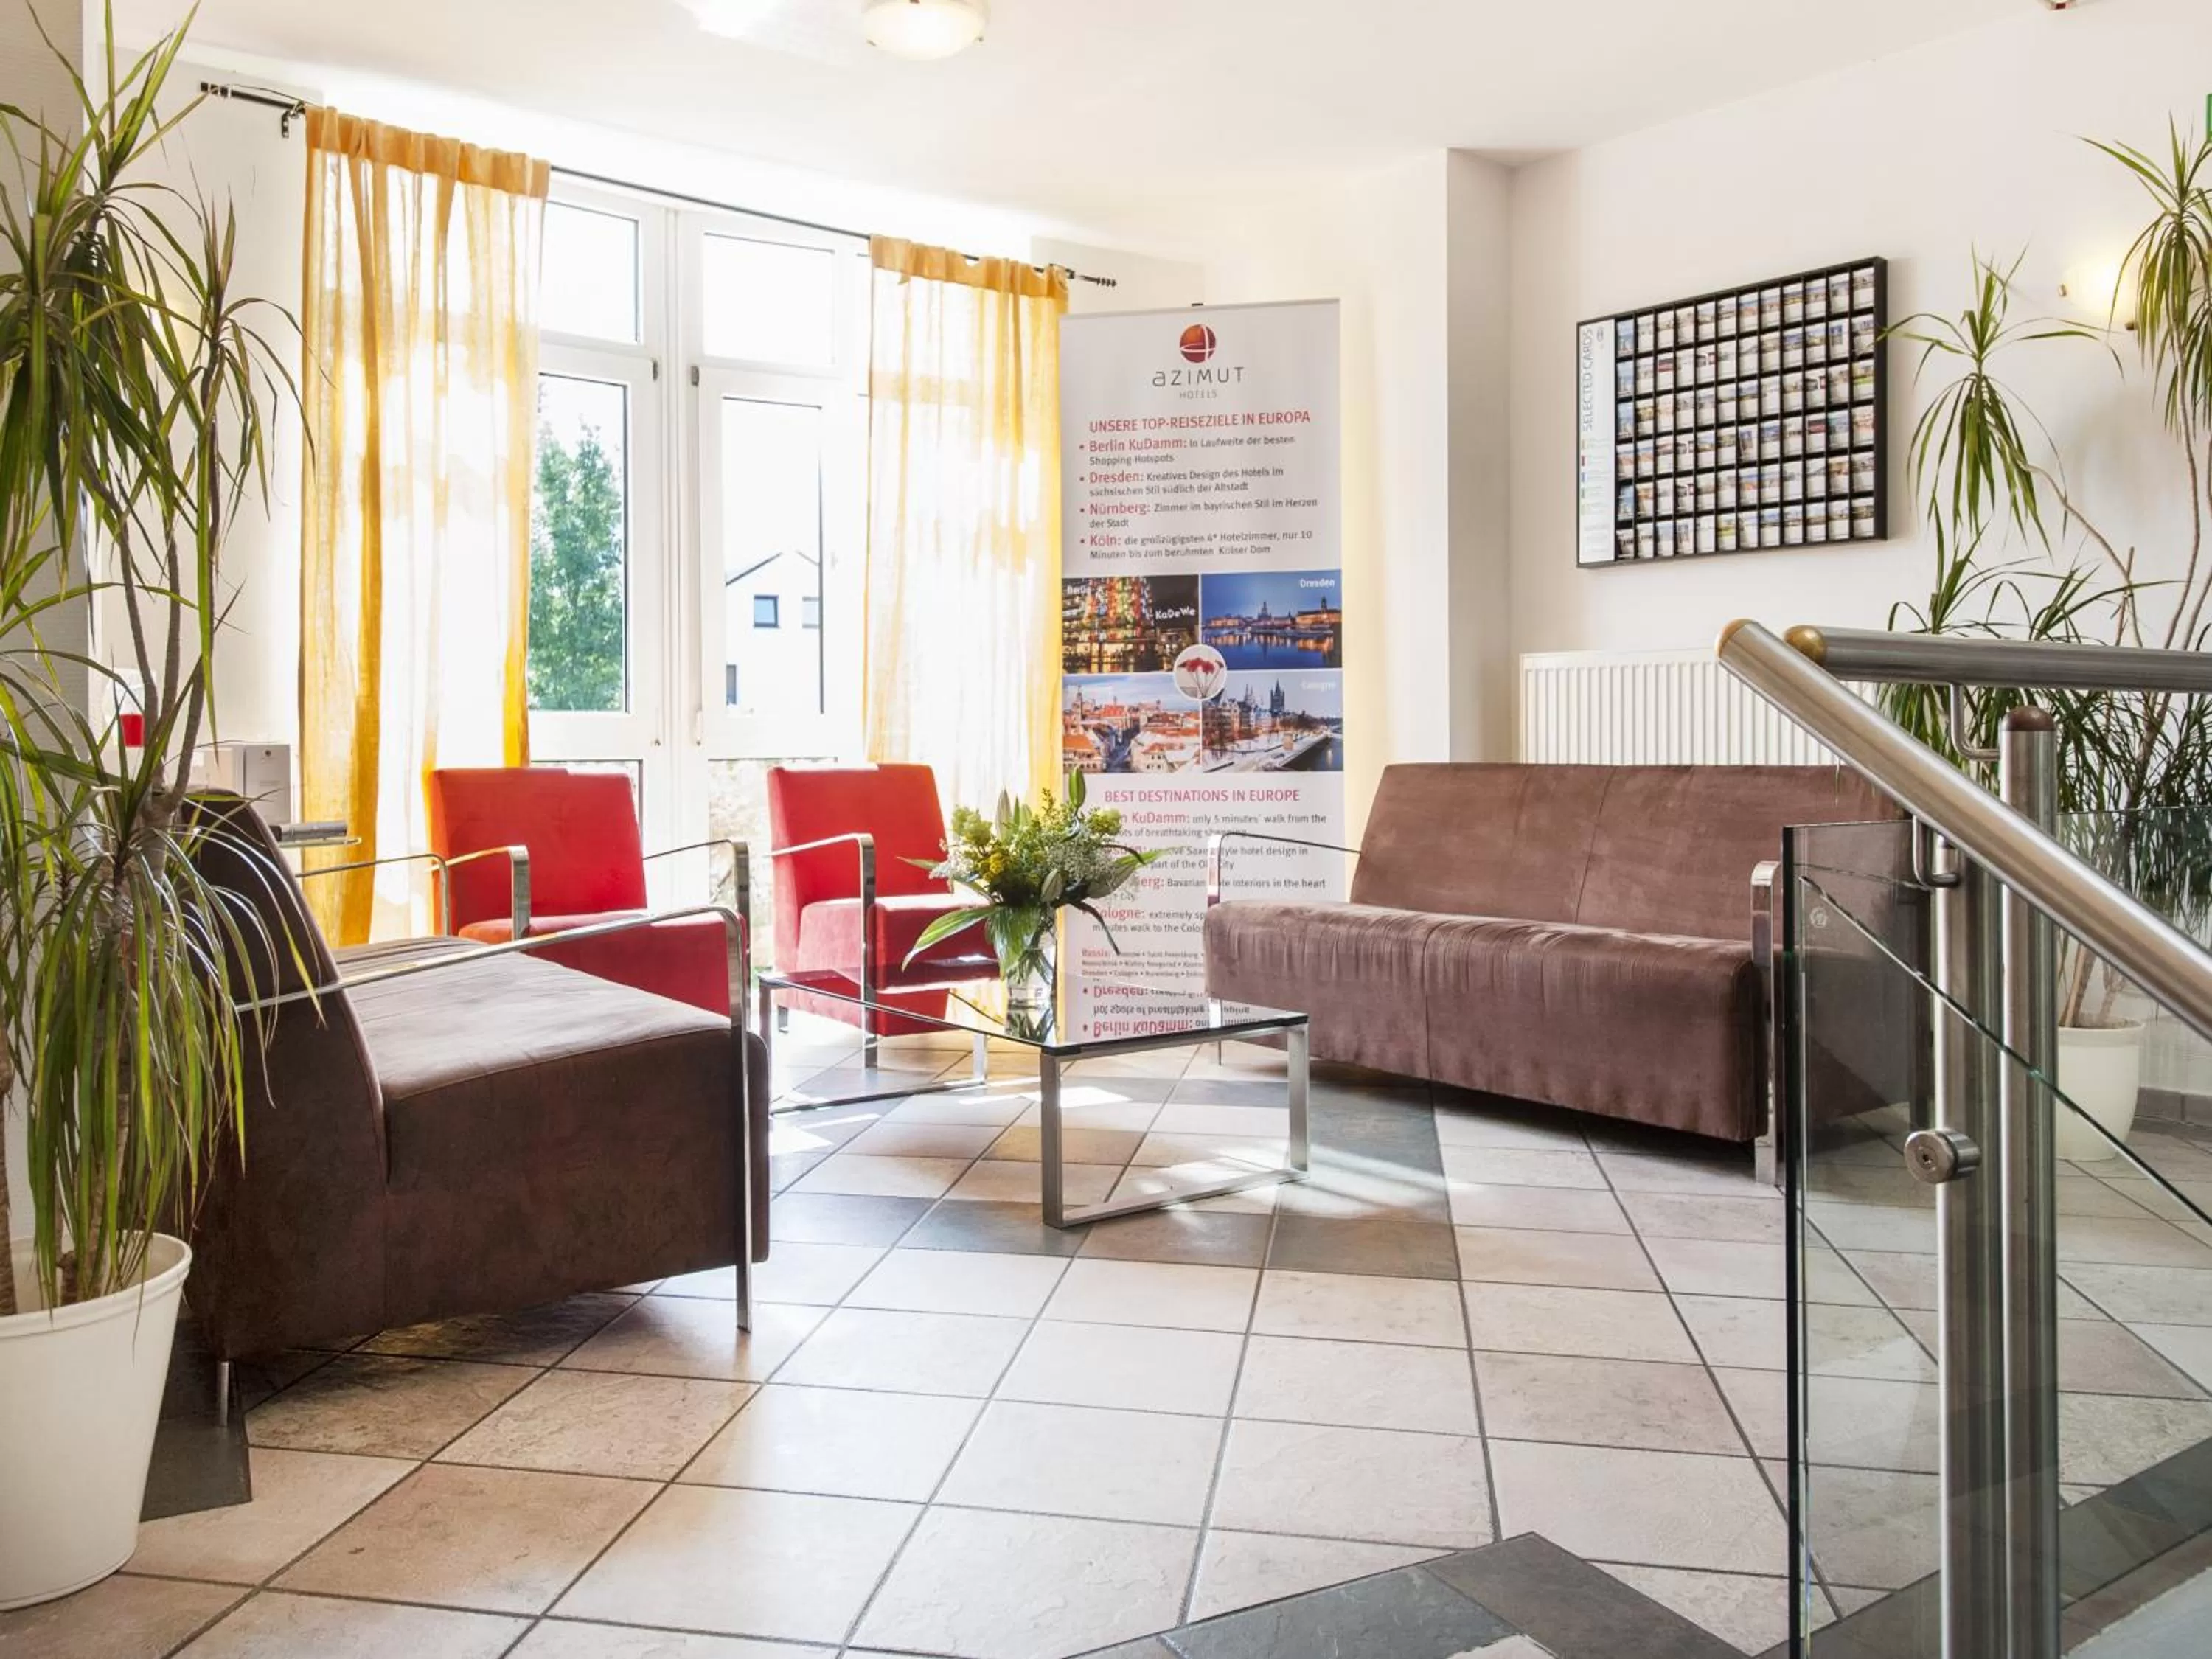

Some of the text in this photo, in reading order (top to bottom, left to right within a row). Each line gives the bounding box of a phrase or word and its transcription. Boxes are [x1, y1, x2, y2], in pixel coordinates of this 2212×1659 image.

[1089, 411, 1310, 433] UNSERE TOP-REISEZIELE IN EUROPA
[1089, 439, 1125, 452] Berlin
[1129, 438, 1187, 451] KuDamm:
[1201, 437, 1244, 448] Laufweite
[1247, 436, 1262, 445] der
[1264, 435, 1294, 445] besten
[1089, 453, 1175, 467] Shopping Hotspots
[1089, 466, 1284, 484] Dresden: Kreatives Design des Hotels im
[1146, 484, 1160, 495] Stil
[1197, 484, 1211, 493] der
[1214, 481, 1248, 492] Altstadt
[1089, 498, 1318, 515] Nürnberg: Zimmer im bayrischen Stil im Herzen
[1089, 518, 1129, 529] der Stadt
[1090, 535, 1121, 546] Köln:
[1124, 536, 1138, 545] die
[1282, 532, 1298, 540] nur
[1301, 530, 1312, 539] 10
[1090, 550, 1126, 560] Minuten
[1129, 550, 1142, 559] bis
[1144, 550, 1162, 558] zum
[1251, 545, 1271, 554] Dom
[1105, 790, 1301, 802] BEST DESTINATIONS IN EUROPE
[1132, 811, 1190, 824] KuDamm:
[1192, 814, 1211, 824] only
[1263, 814, 1284, 823] walk
[1288, 814, 1309, 823] from
[1311, 813, 1326, 823] the
[1135, 827, 1143, 836] of
[1144, 827, 1203, 838] breathtaking
[1240, 846, 1263, 855] hotel
[1266, 846, 1294, 857] design
[1298, 846, 1308, 855] in
[1170, 859, 1179, 869] of
[1181, 859, 1197, 868] the
[1167, 878, 1207, 887] Bavarian
[1232, 878, 1270, 887] interiors
[1273, 878, 1281, 887] in
[1284, 878, 1300, 887] the
[1301, 878, 1326, 888] heart
[1149, 911, 1192, 921] extremely
[1130, 923, 1150, 933] walk
[1153, 924, 1163, 933] to
[1164, 923, 1179, 933] the
